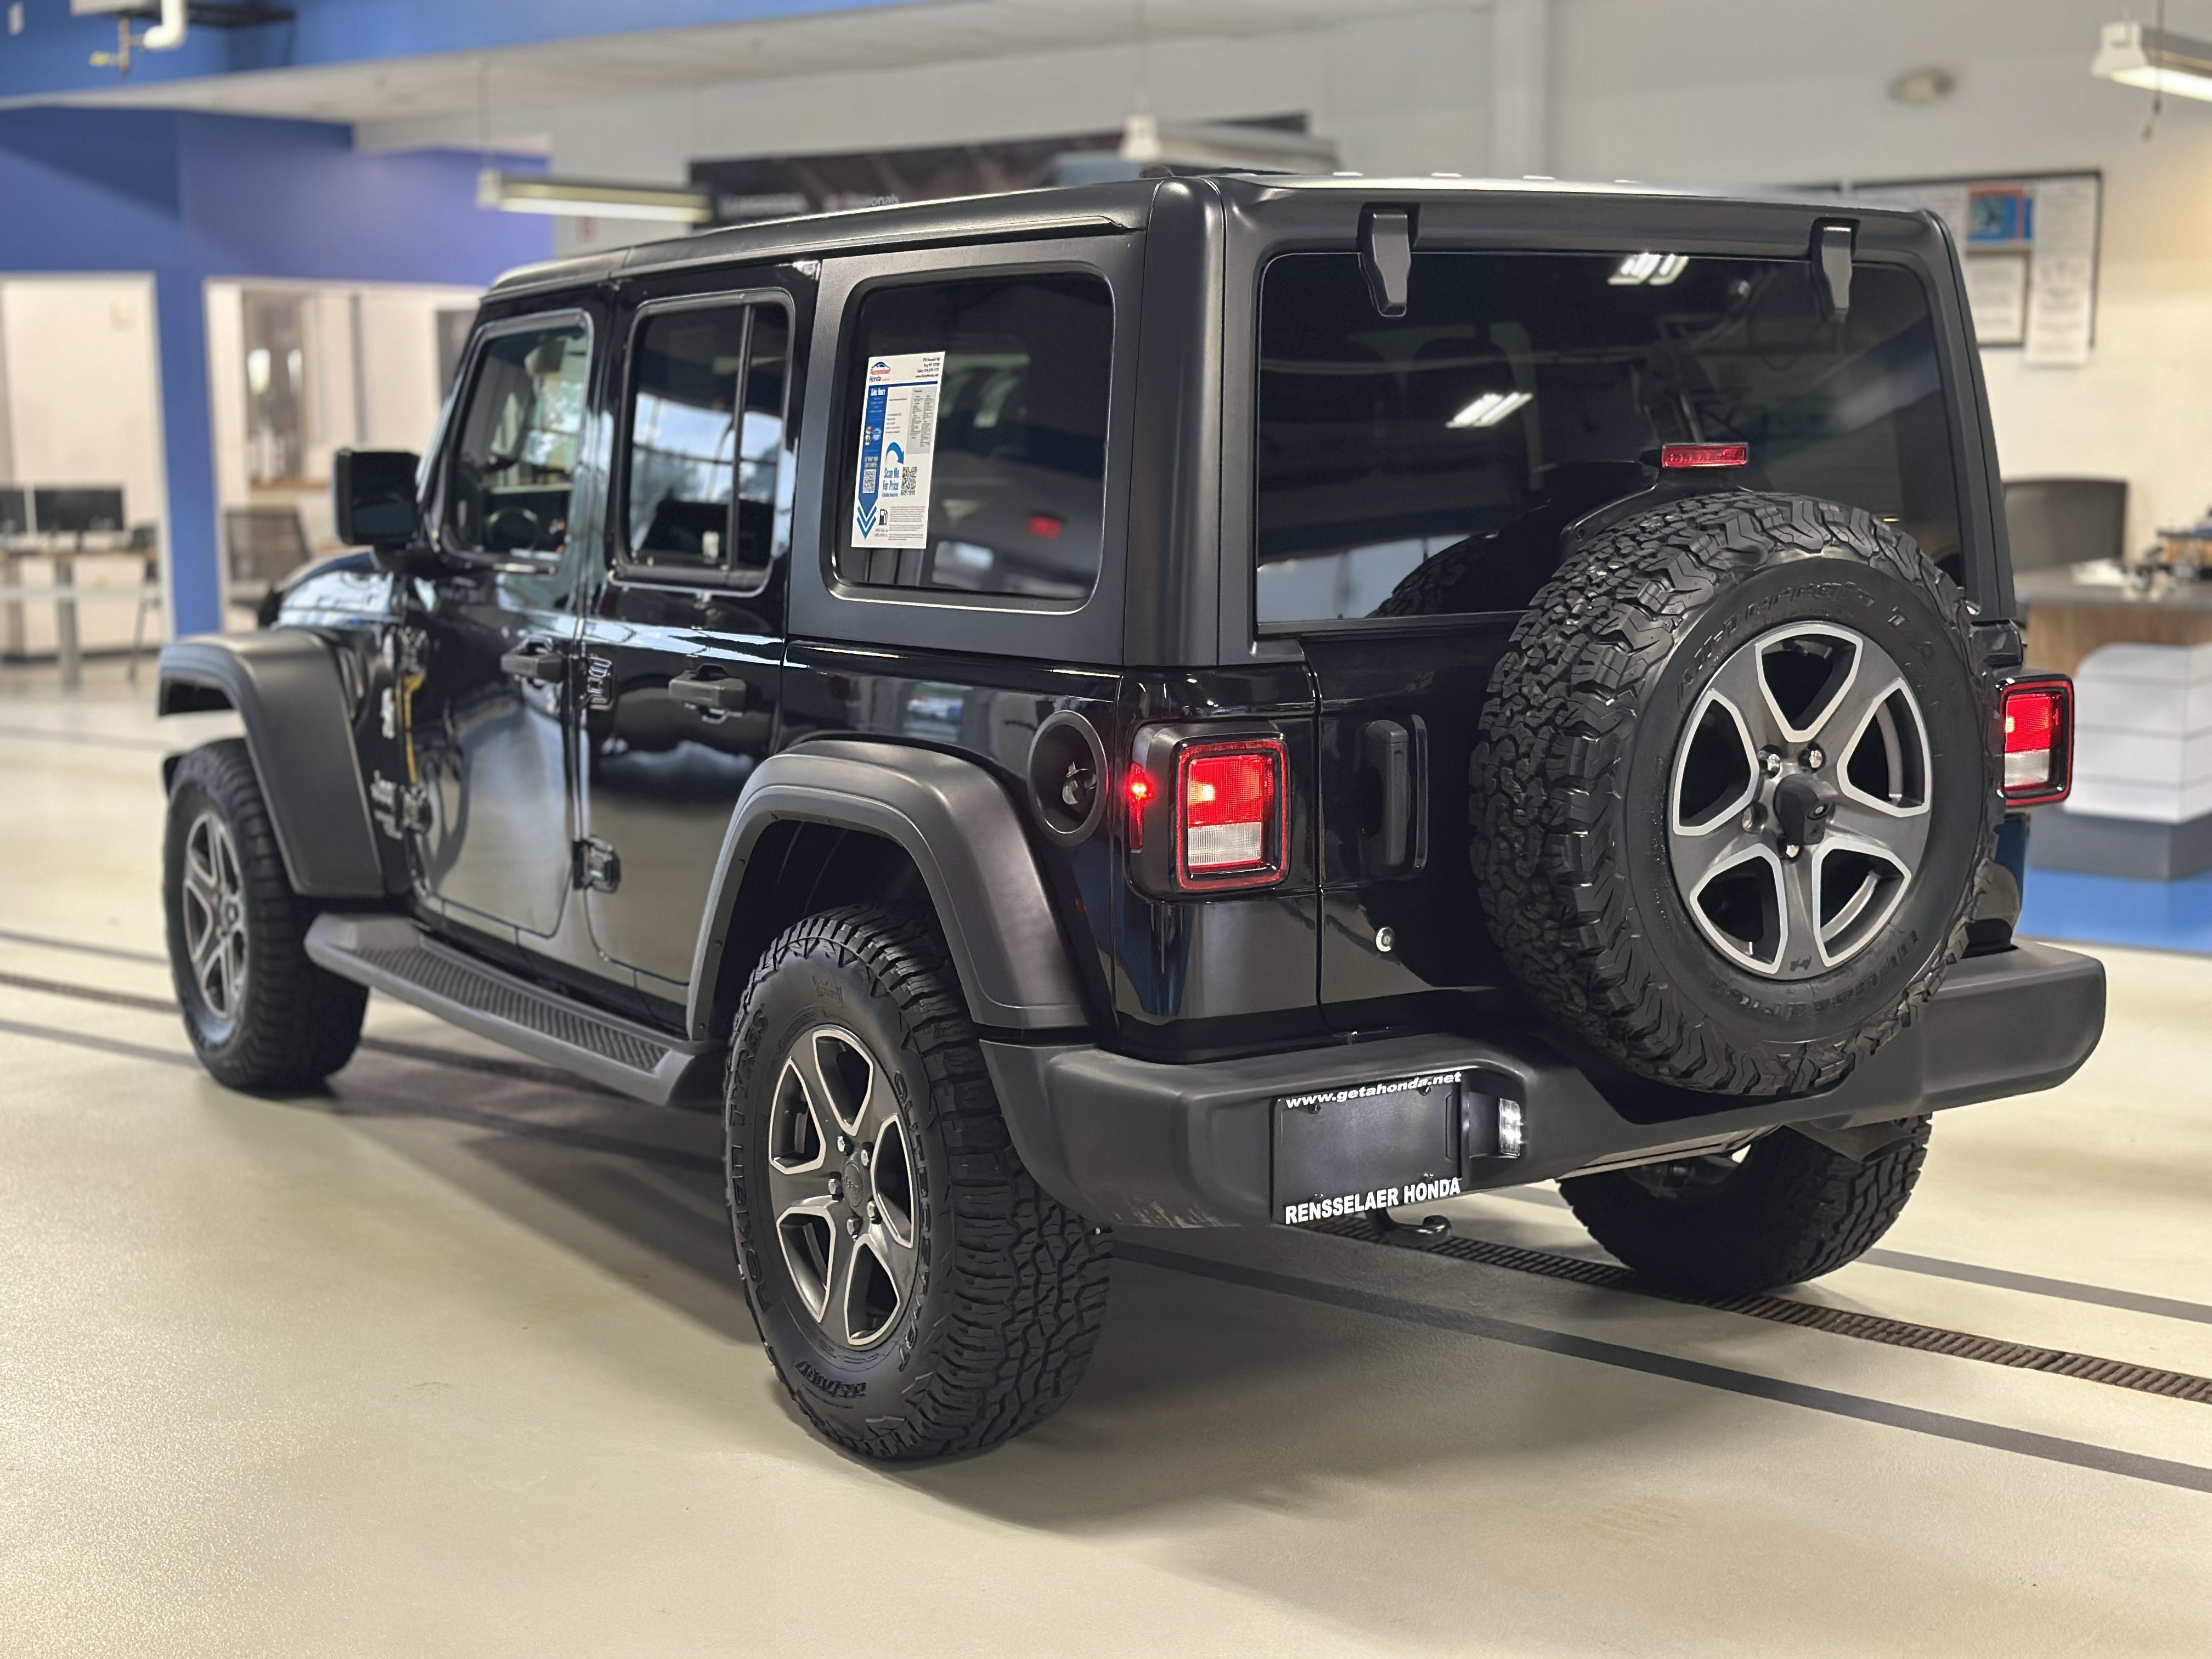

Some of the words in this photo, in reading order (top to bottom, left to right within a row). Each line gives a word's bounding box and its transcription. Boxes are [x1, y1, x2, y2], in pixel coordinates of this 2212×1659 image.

[884, 467, 893, 478] Scan
[893, 467, 900, 478] Me
[889, 479, 899, 490] Price
[1286, 1071, 1462, 1108] www.getahonda.net
[1285, 1187, 1398, 1225] RENSSELAER
[1403, 1177, 1461, 1204] HONDA
